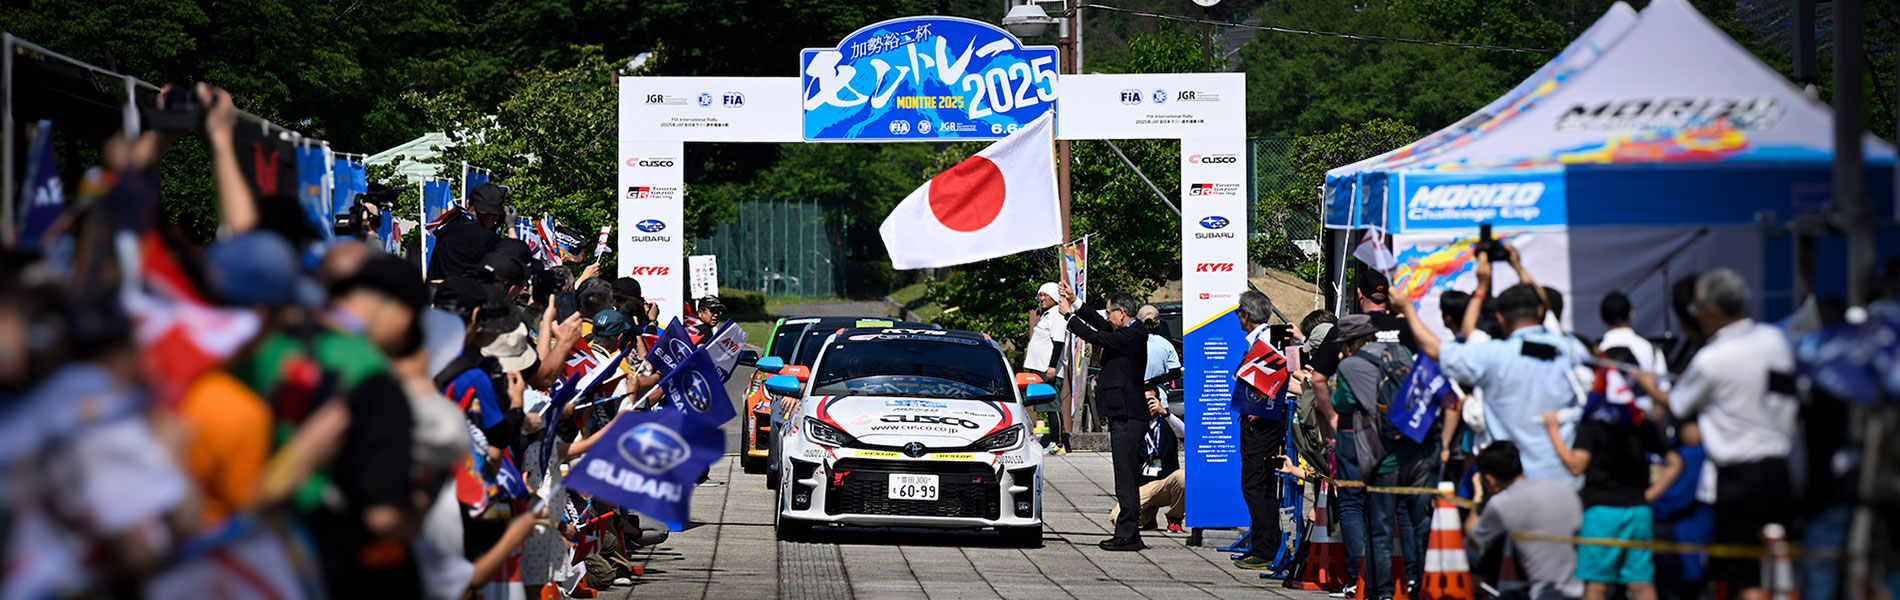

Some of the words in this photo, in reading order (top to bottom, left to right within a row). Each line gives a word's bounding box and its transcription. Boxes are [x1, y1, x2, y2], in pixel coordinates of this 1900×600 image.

[962, 56, 1058, 120] 2025
[645, 94, 664, 104] JGR
[1177, 90, 1196, 100] JGR
[896, 96, 937, 109] MONTRE
[938, 96, 964, 109] 2025
[939, 122, 956, 131] JGR
[1201, 156, 1236, 164] CUSCO
[1407, 182, 1545, 208] MORIZO
[1499, 206, 1540, 221] Cup
[631, 235, 671, 243] SUBARU
[632, 266, 670, 275] KYB
[1196, 262, 1234, 272] KYB
[879, 414, 980, 430] CUSCO
[870, 424, 958, 434] www.cusco.co.jp
[585, 457, 683, 502] SUBARU
[915, 476, 928, 484] 300
[899, 484, 936, 498] 60-99
